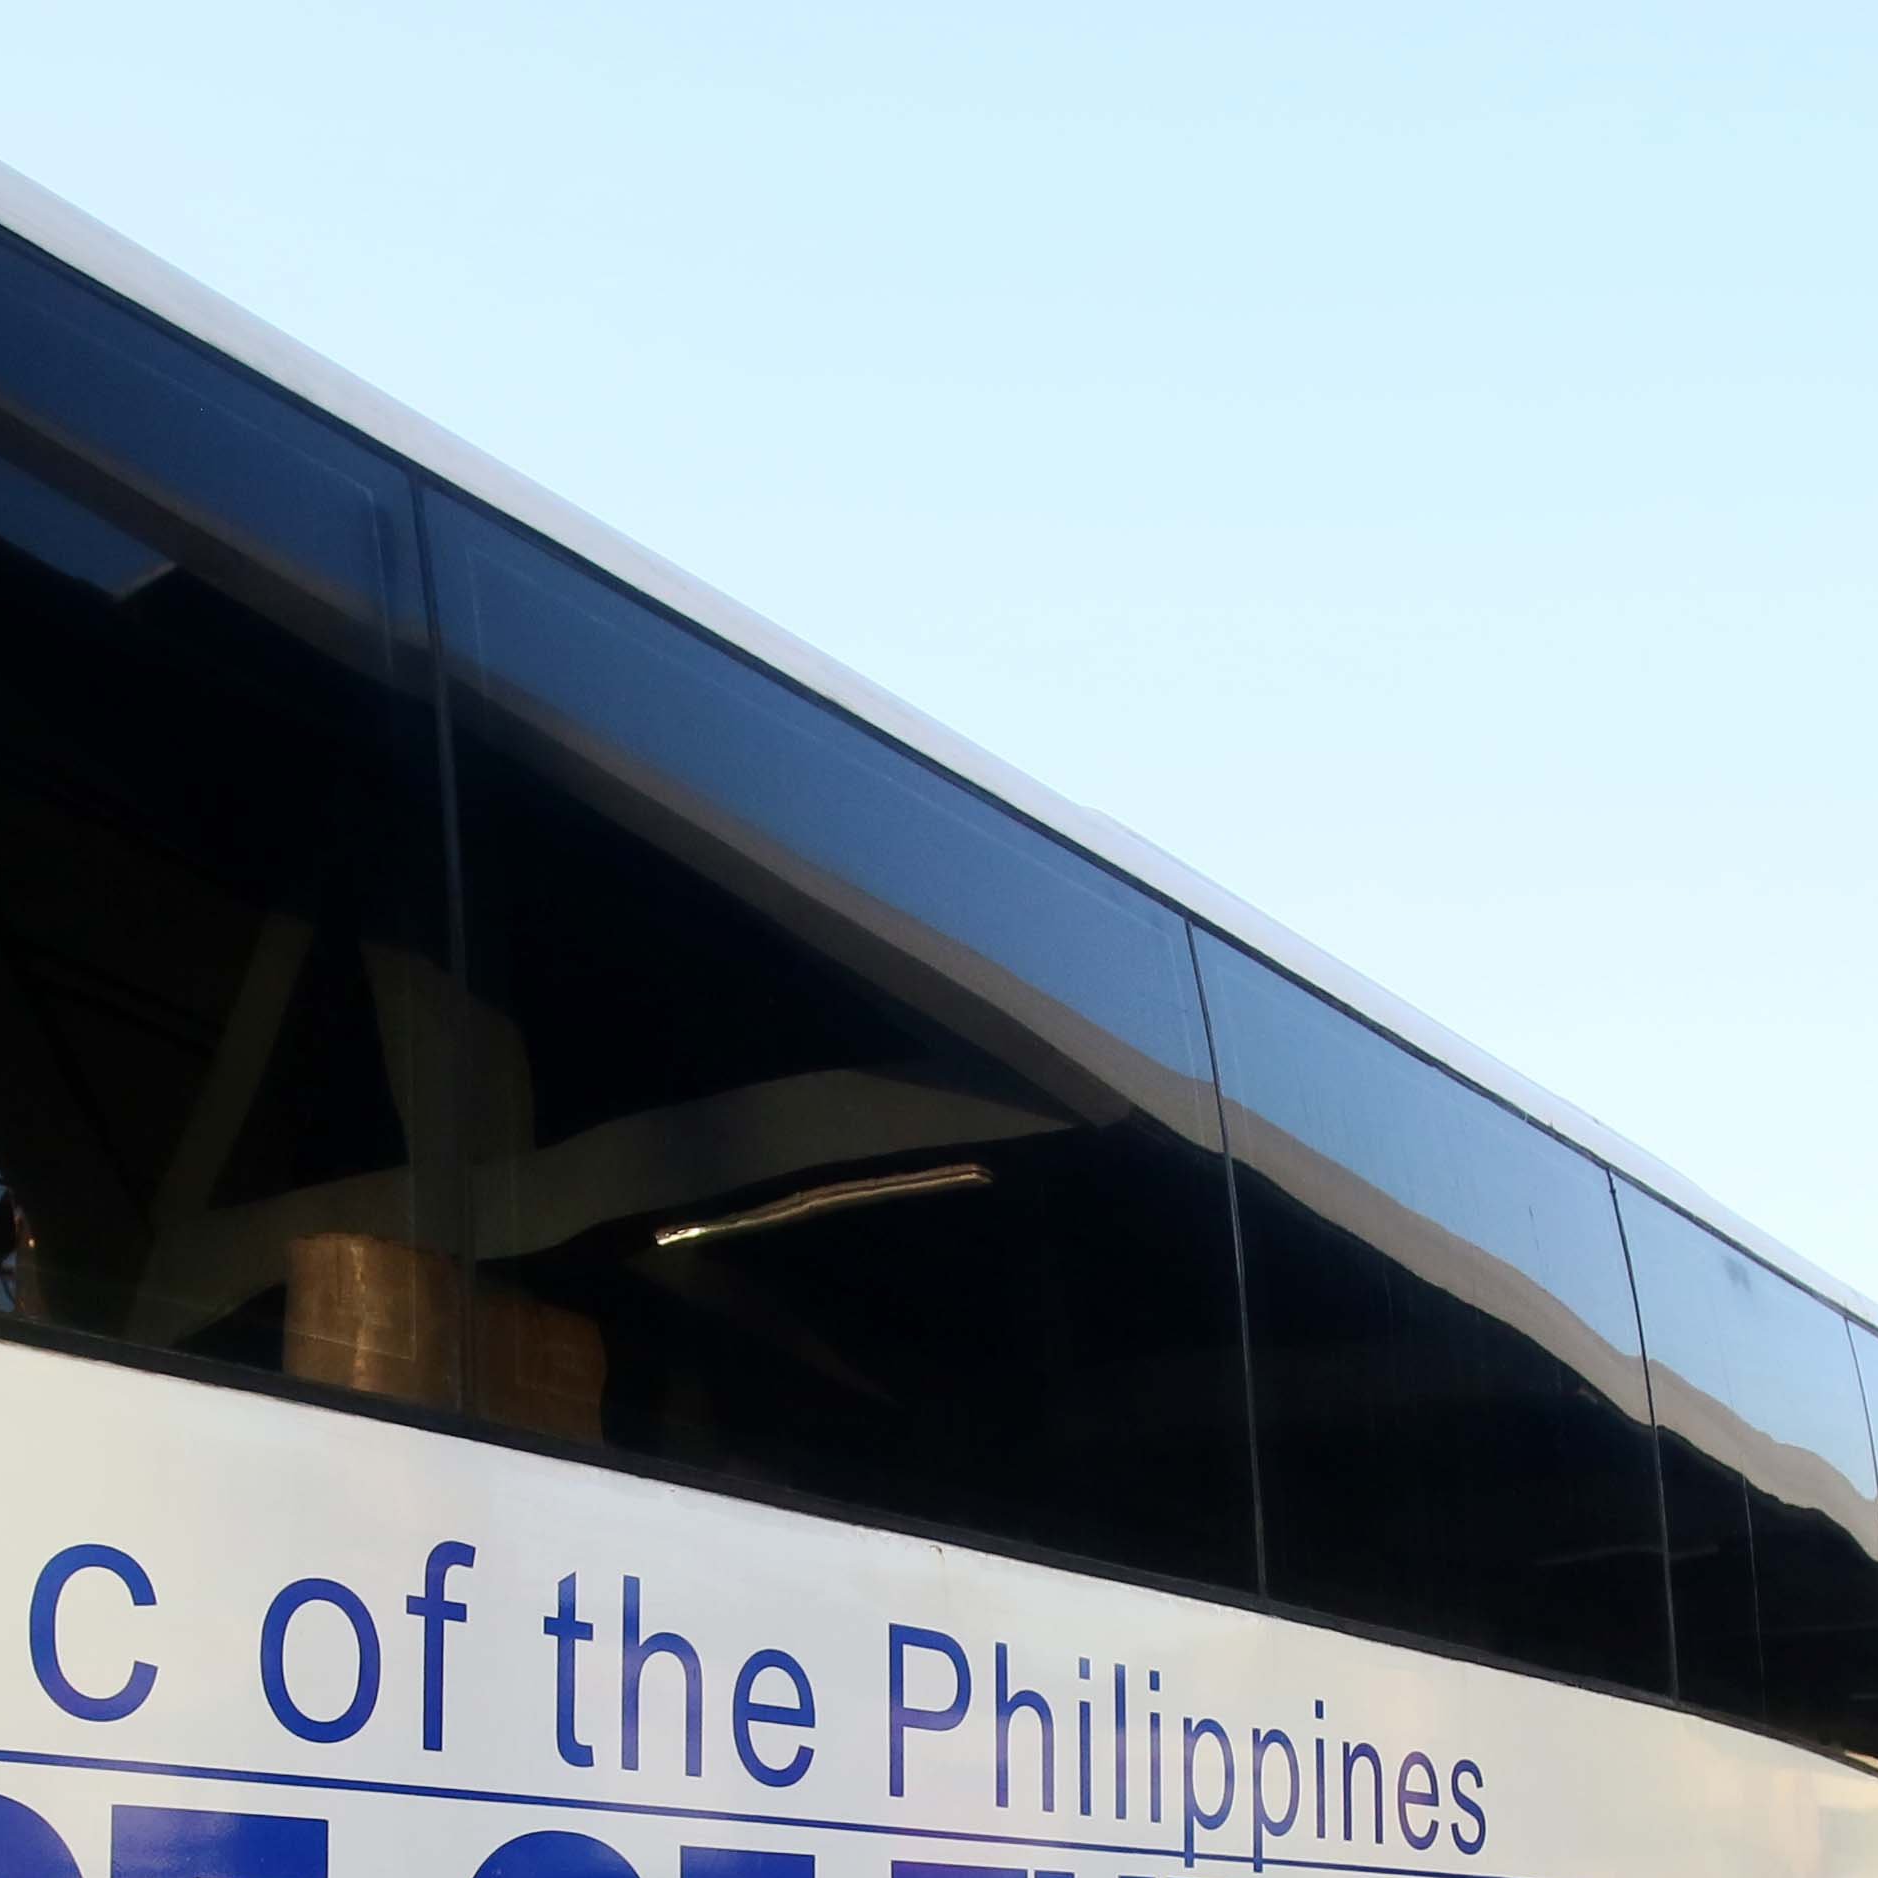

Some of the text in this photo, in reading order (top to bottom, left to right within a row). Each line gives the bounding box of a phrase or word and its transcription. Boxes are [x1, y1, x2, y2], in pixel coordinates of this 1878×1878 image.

[260, 1540, 476, 1751] of
[543, 1571, 816, 1788] the
[888, 1622, 1487, 1873] Philippines
